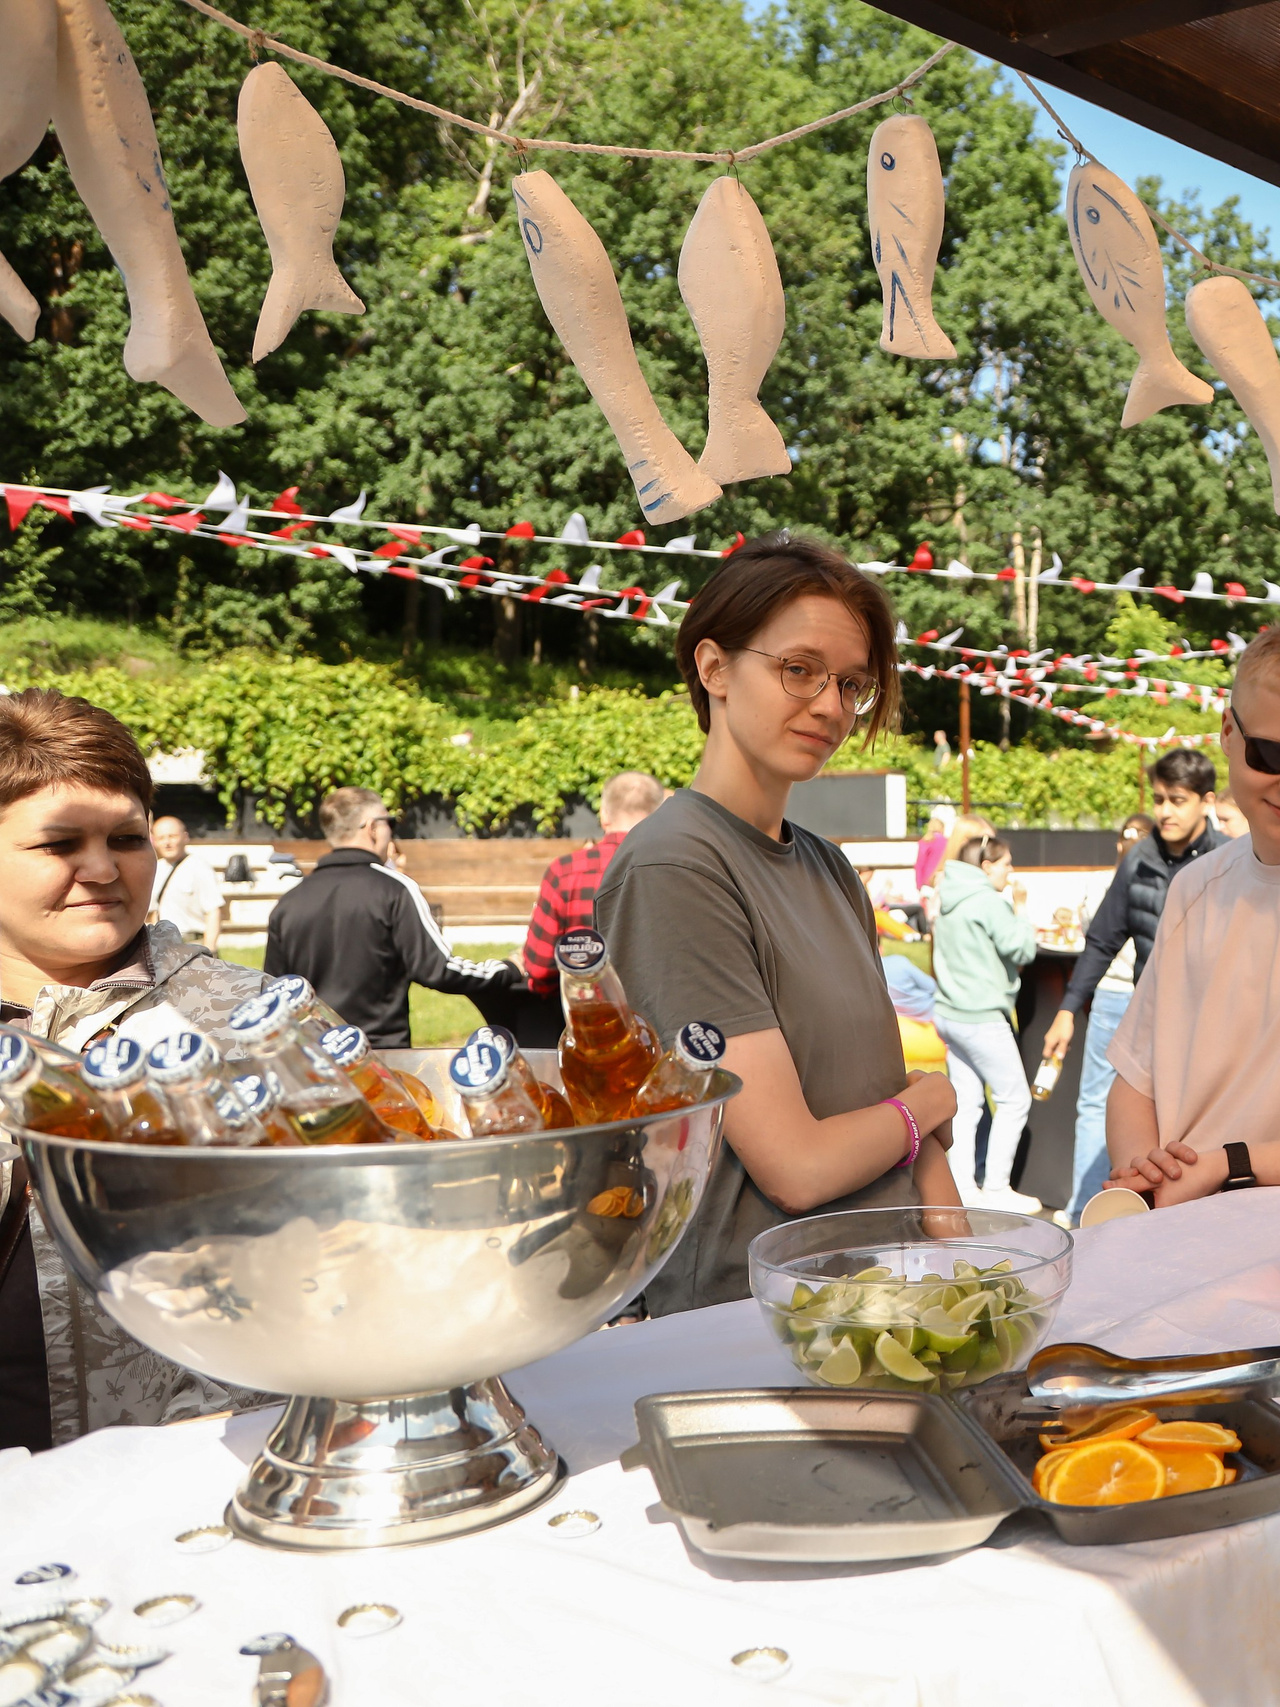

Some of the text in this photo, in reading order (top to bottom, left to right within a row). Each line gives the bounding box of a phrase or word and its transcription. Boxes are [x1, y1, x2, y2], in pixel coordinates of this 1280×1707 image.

[567, 935, 592, 944] Extra
[558, 941, 604, 955] Corona
[688, 1022, 719, 1059] Corona
